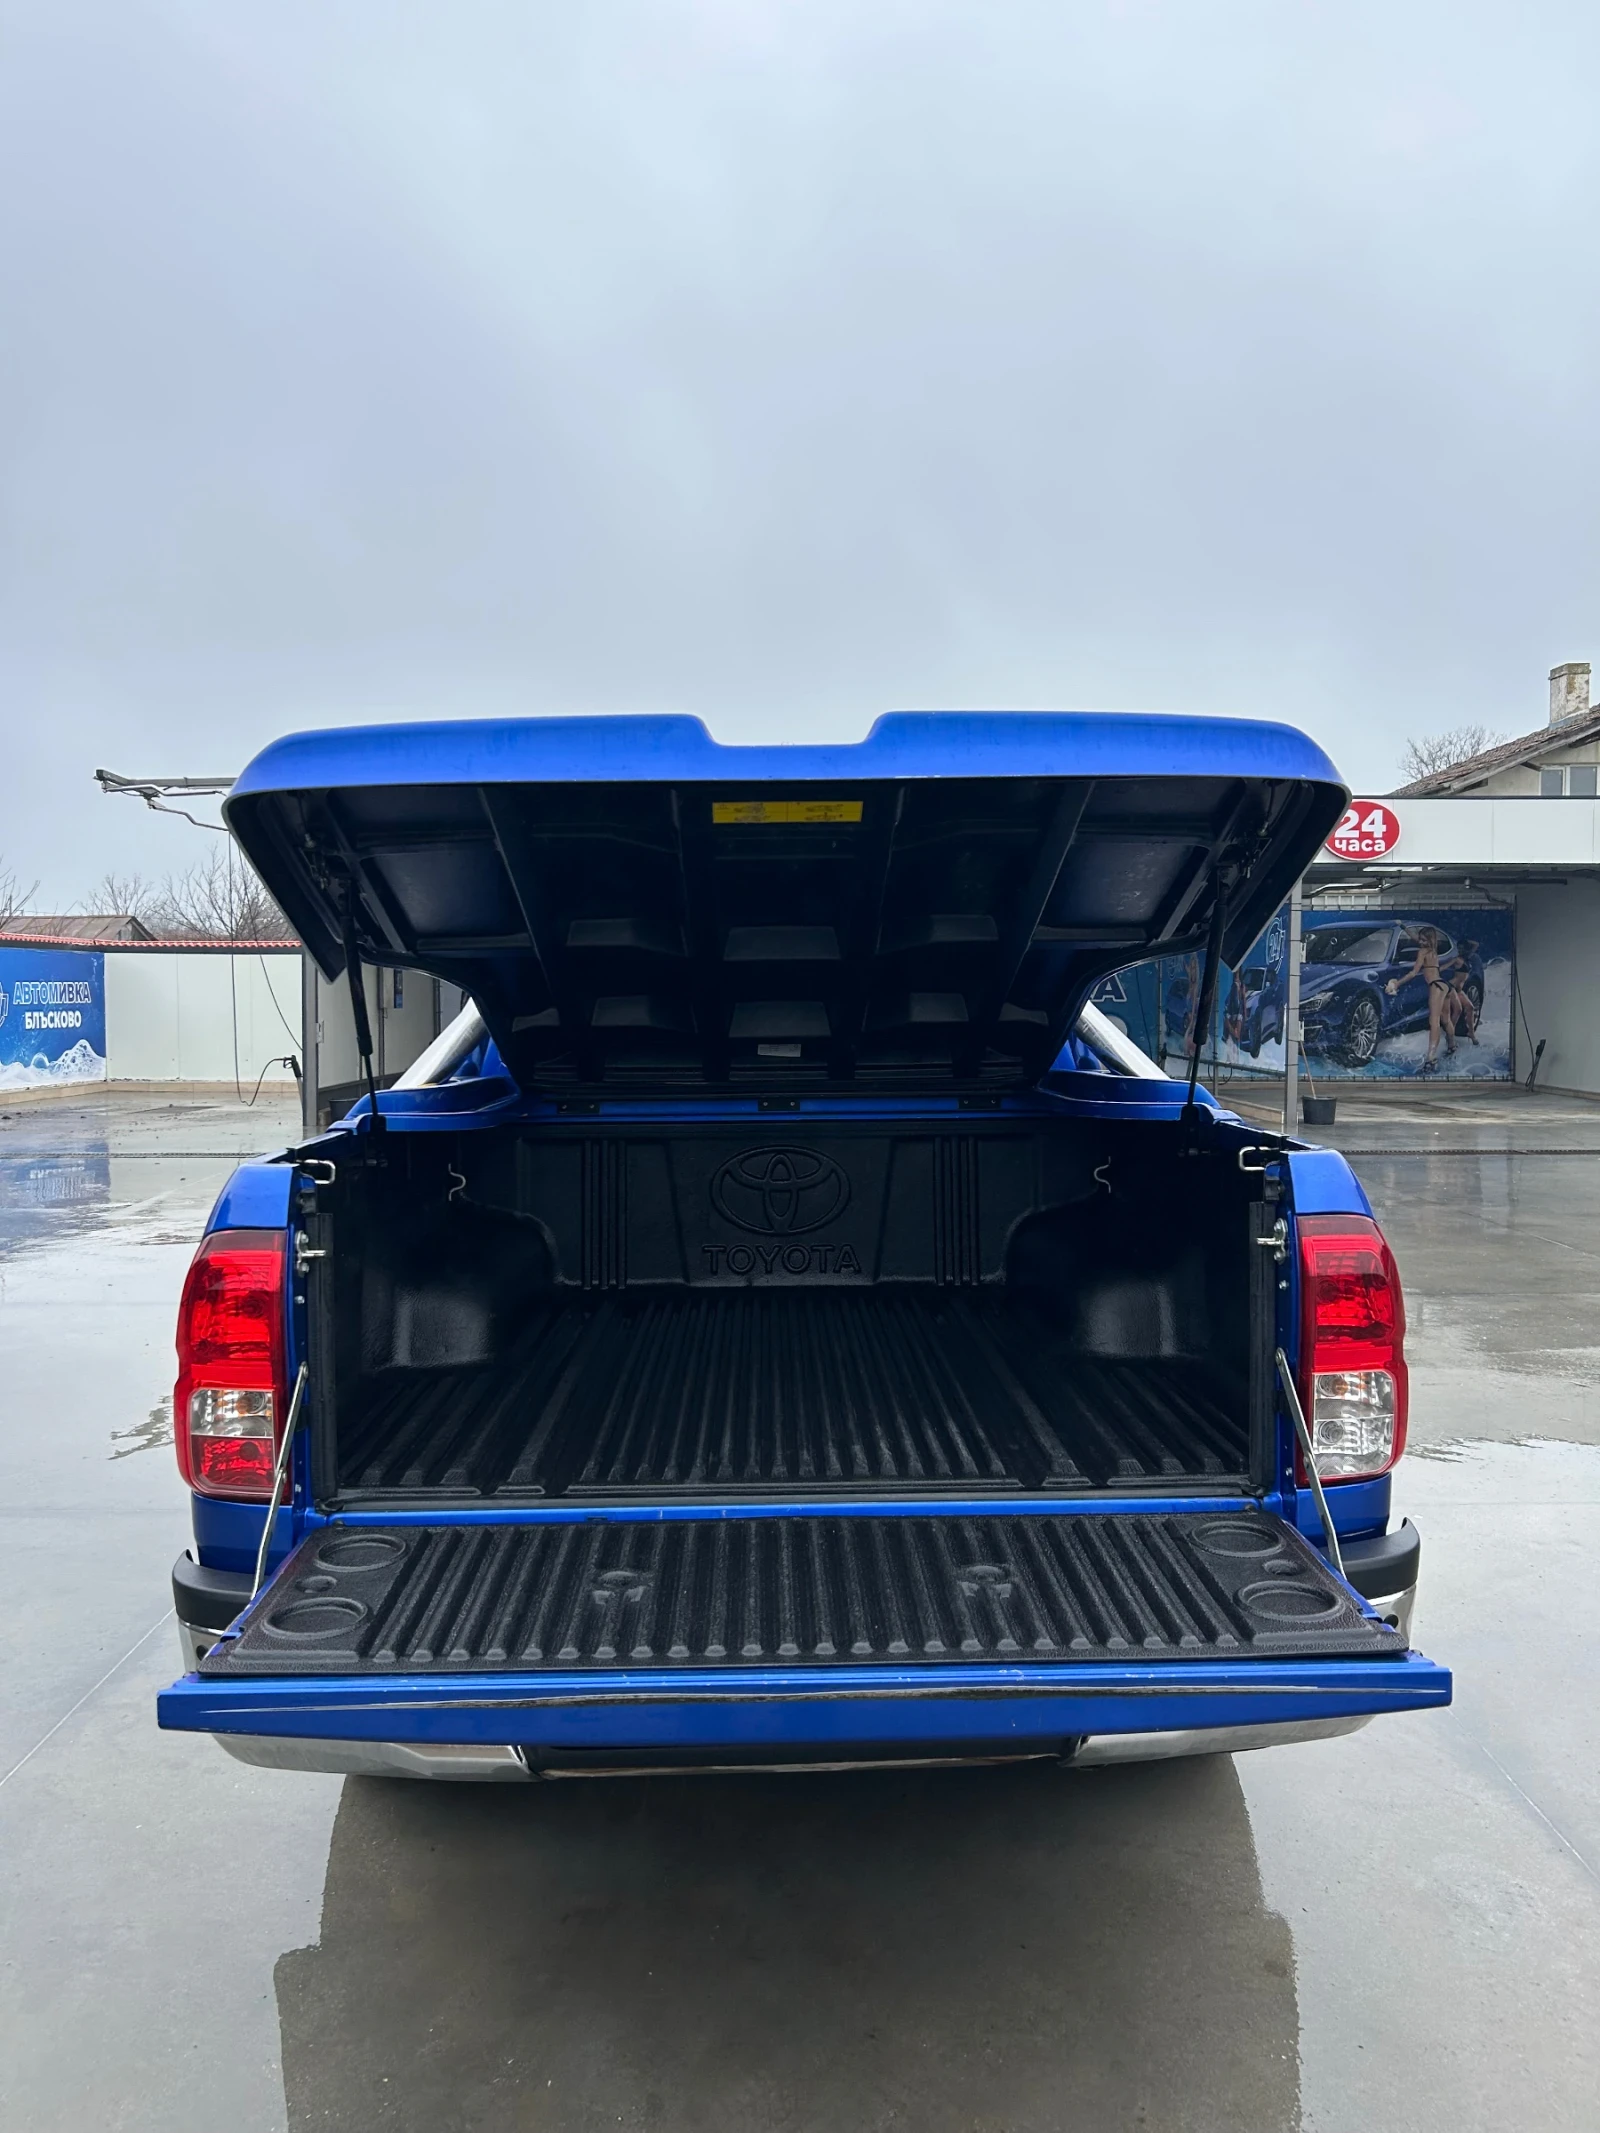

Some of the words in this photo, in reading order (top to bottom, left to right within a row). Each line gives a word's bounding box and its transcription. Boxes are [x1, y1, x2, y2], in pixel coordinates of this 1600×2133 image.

[1334, 809, 1387, 838] 24
[1334, 839, 1386, 852] часа
[13, 981, 92, 1005] АВТОМИВКА
[25, 1010, 82, 1030] БЛЪСКОВО
[702, 1244, 862, 1275] TOYOTA
